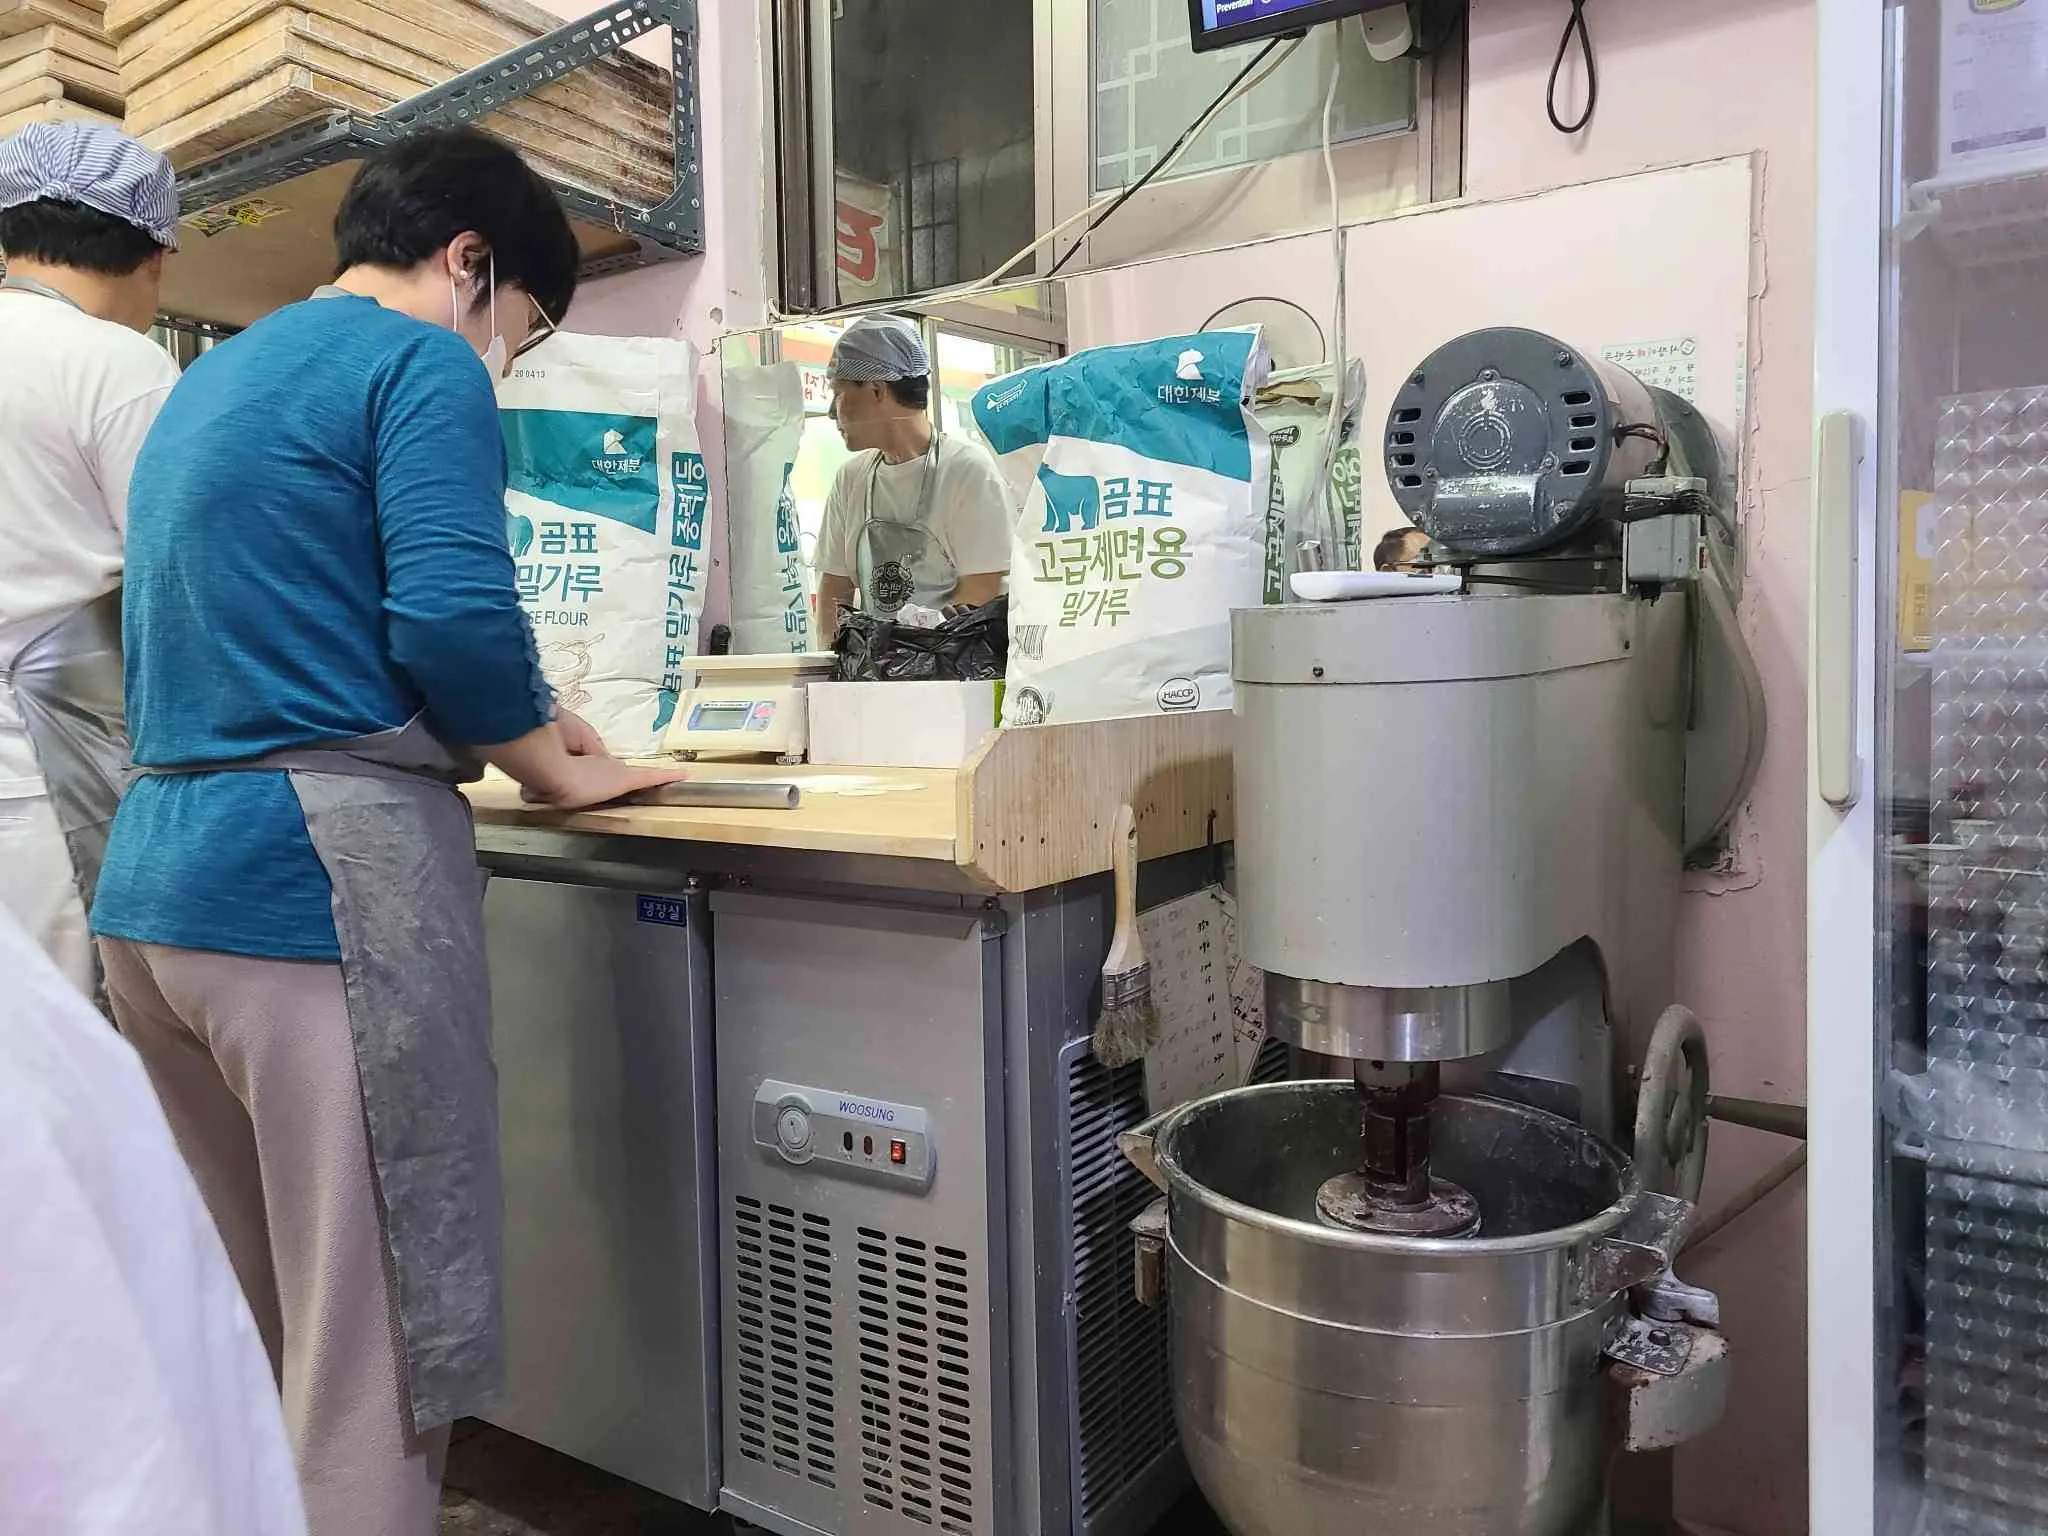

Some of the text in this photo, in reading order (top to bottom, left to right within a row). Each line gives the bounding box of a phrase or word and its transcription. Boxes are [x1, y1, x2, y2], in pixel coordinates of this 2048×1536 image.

[591, 458, 641, 475] 대한제분
[673, 457, 707, 544] 중력1등
[1103, 477, 1173, 520] 곰표
[539, 521, 599, 554] 곰표
[1033, 526, 1194, 586] 고급제면용
[516, 563, 604, 604] 밀가루
[665, 551, 699, 639] 밀가루
[545, 611, 589, 627] FLOUR
[1058, 588, 1131, 628] 밀가루
[1163, 688, 1194, 699] HACCP
[642, 901, 681, 921] 냉장실
[839, 1100, 895, 1122] WOOSUNG
